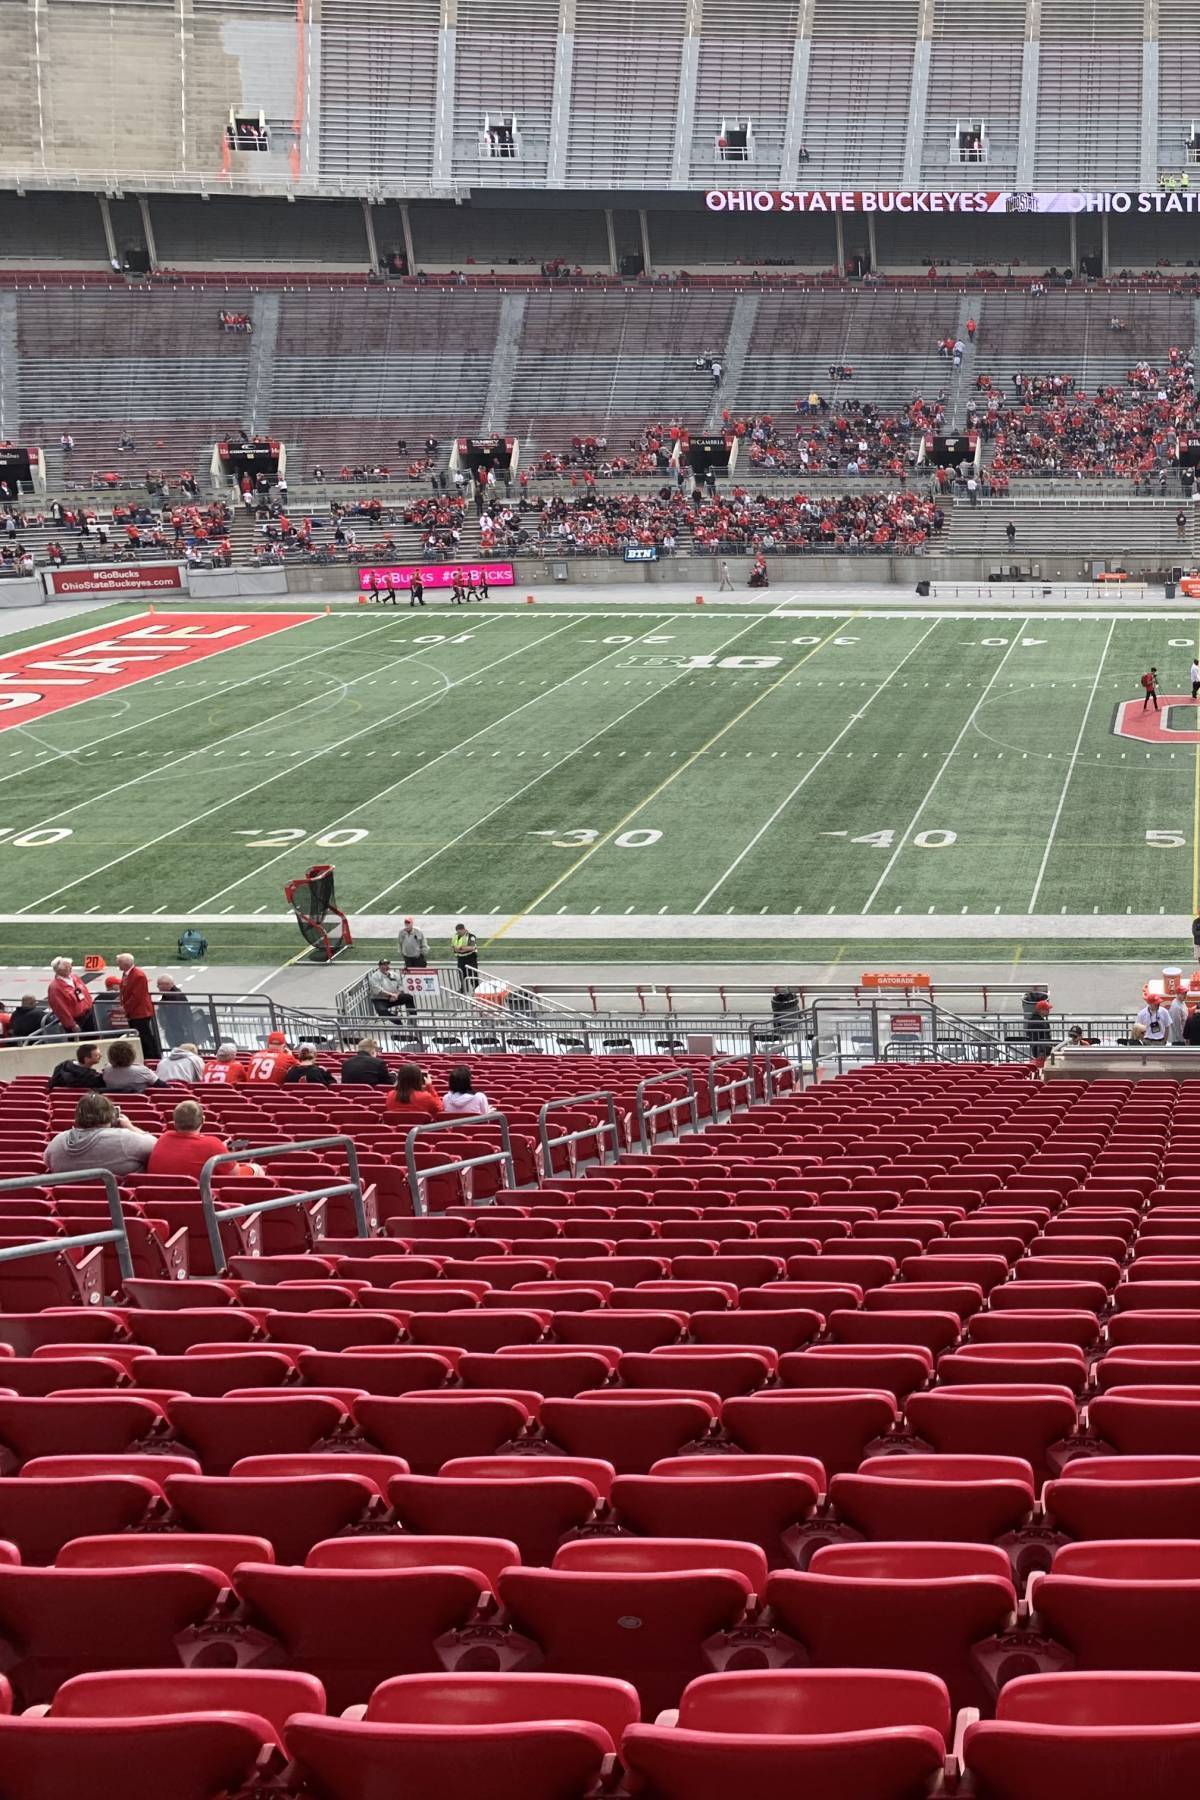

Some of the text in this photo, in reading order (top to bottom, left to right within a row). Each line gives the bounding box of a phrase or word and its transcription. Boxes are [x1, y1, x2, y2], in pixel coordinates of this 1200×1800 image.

[706, 191, 989, 212] OHIO STATE BUCKEYES
[628, 549, 652, 559] BTN
[61, 578, 174, 591] OhioStateBuckeyes.com
[93, 570, 140, 580] #GoBucks
[244, 828, 370, 847] 20
[551, 828, 663, 848] 30
[849, 829, 958, 848] 40
[86, 956, 100, 969] 20
[249, 1058, 276, 1080] 79
